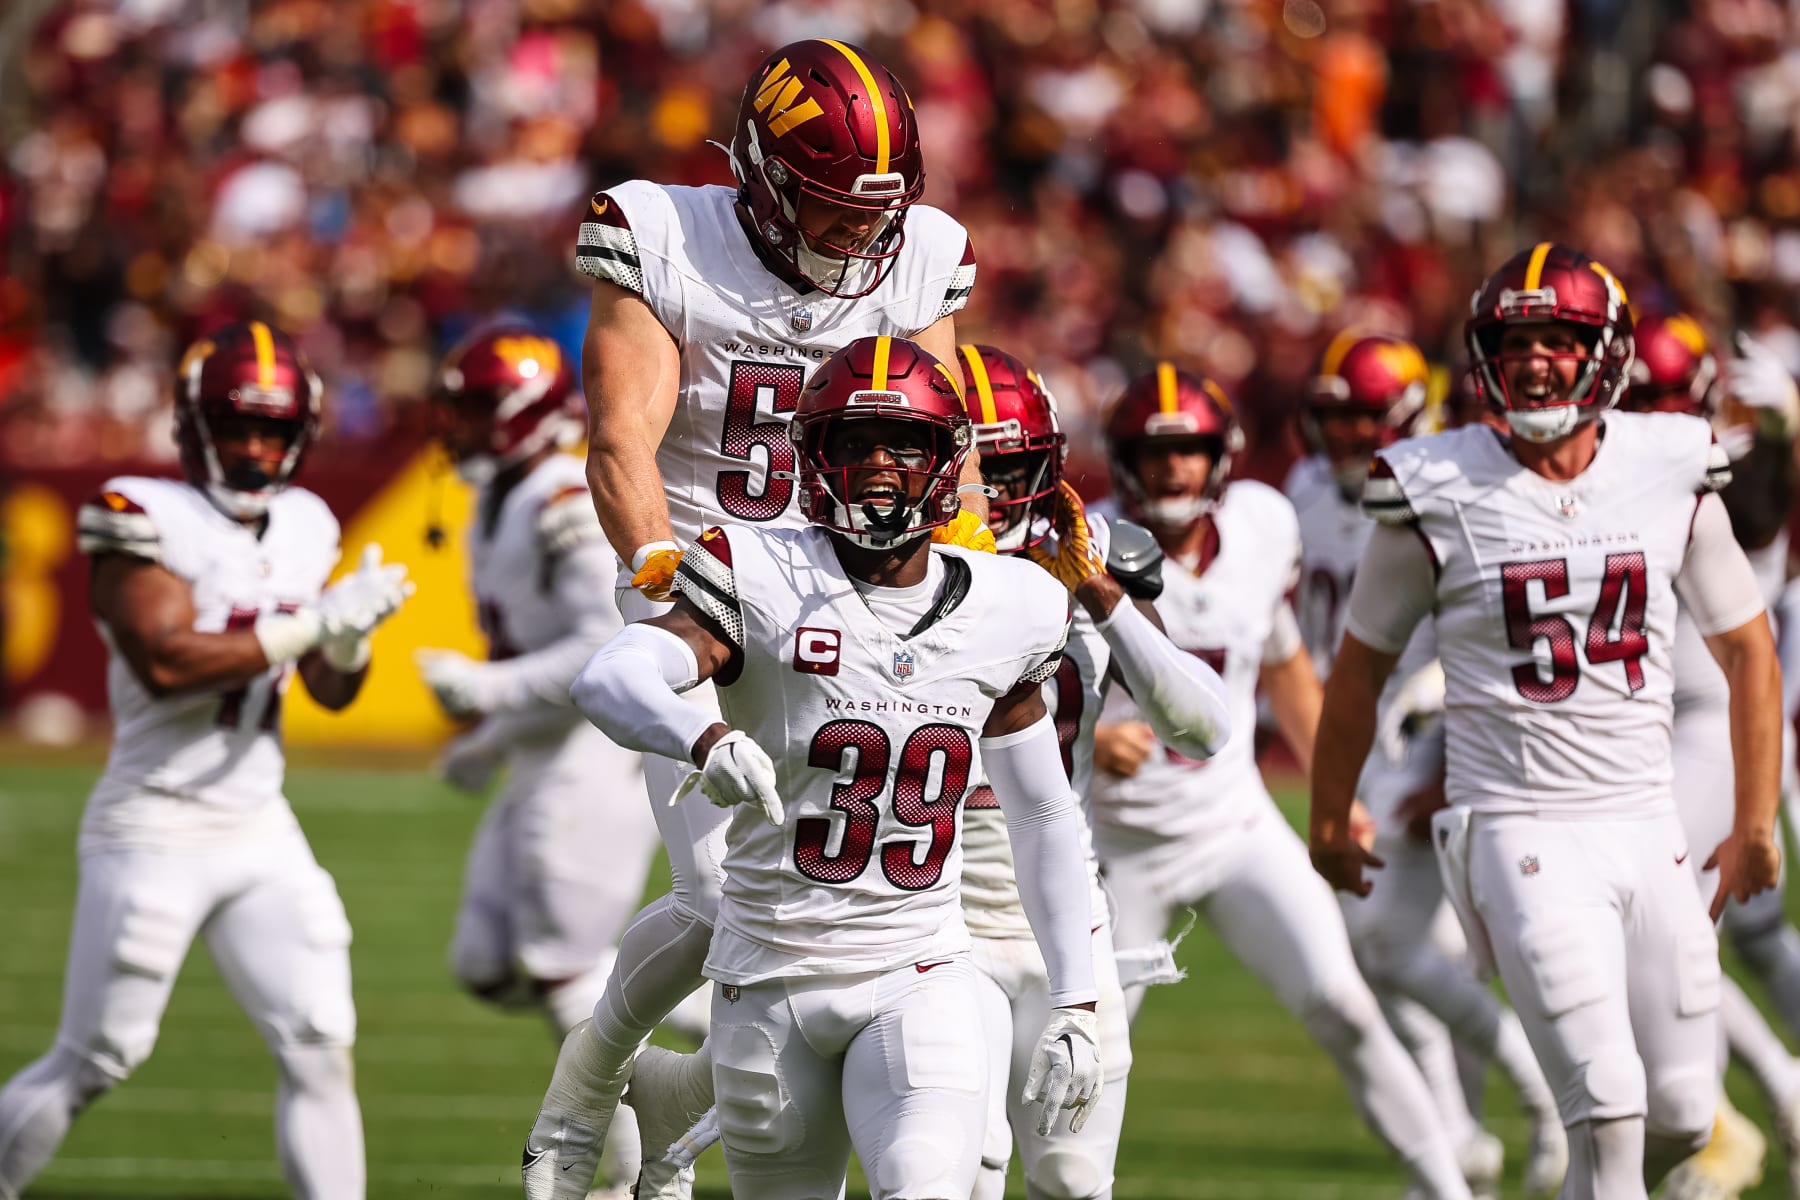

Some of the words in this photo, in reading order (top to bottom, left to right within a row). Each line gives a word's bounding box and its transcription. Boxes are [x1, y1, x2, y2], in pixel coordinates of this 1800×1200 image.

[724, 343, 834, 359] WASHING
[1501, 551, 1648, 704] 54
[798, 630, 839, 664] C
[825, 698, 972, 717] WASHINGTON
[793, 718, 972, 891] 39
